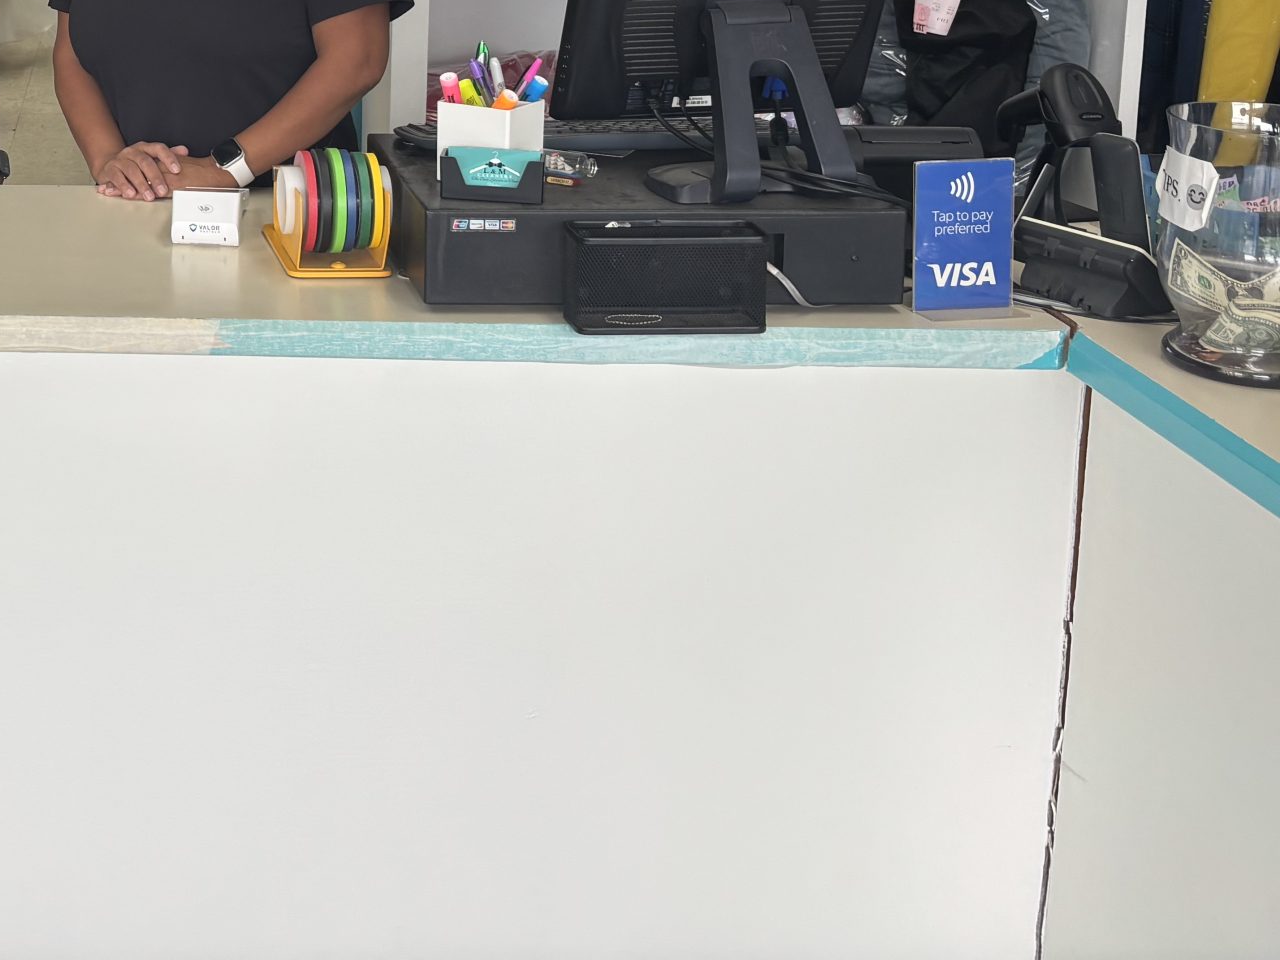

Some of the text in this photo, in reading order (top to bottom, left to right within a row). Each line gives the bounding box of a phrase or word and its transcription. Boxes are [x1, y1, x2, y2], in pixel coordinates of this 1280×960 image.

[931, 210, 994, 223] Tap to pay
[934, 222, 991, 237] preferred
[926, 262, 996, 287] VISA
